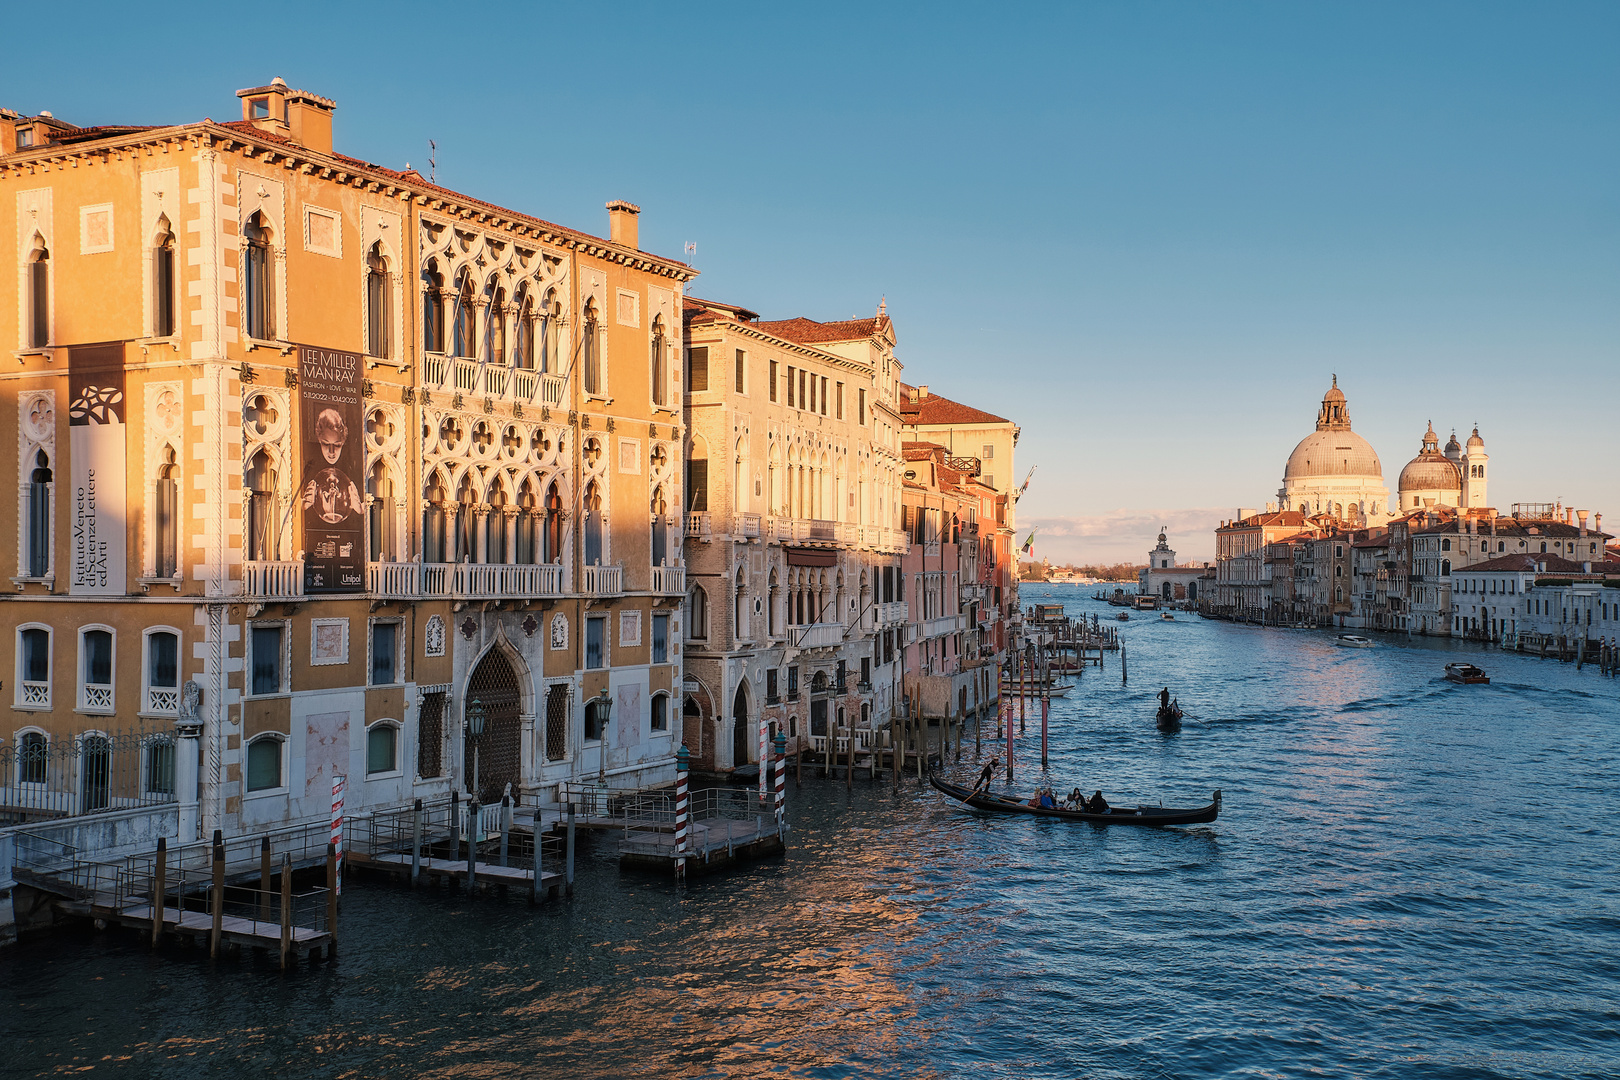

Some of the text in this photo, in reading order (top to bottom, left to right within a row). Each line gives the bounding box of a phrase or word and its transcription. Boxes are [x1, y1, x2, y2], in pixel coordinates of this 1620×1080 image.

[302, 348, 356, 370] LEE MILLER
[304, 365, 354, 384] MAN RAY
[302, 380, 326, 390] FASHION
[342, 574, 361, 585] Unipol
